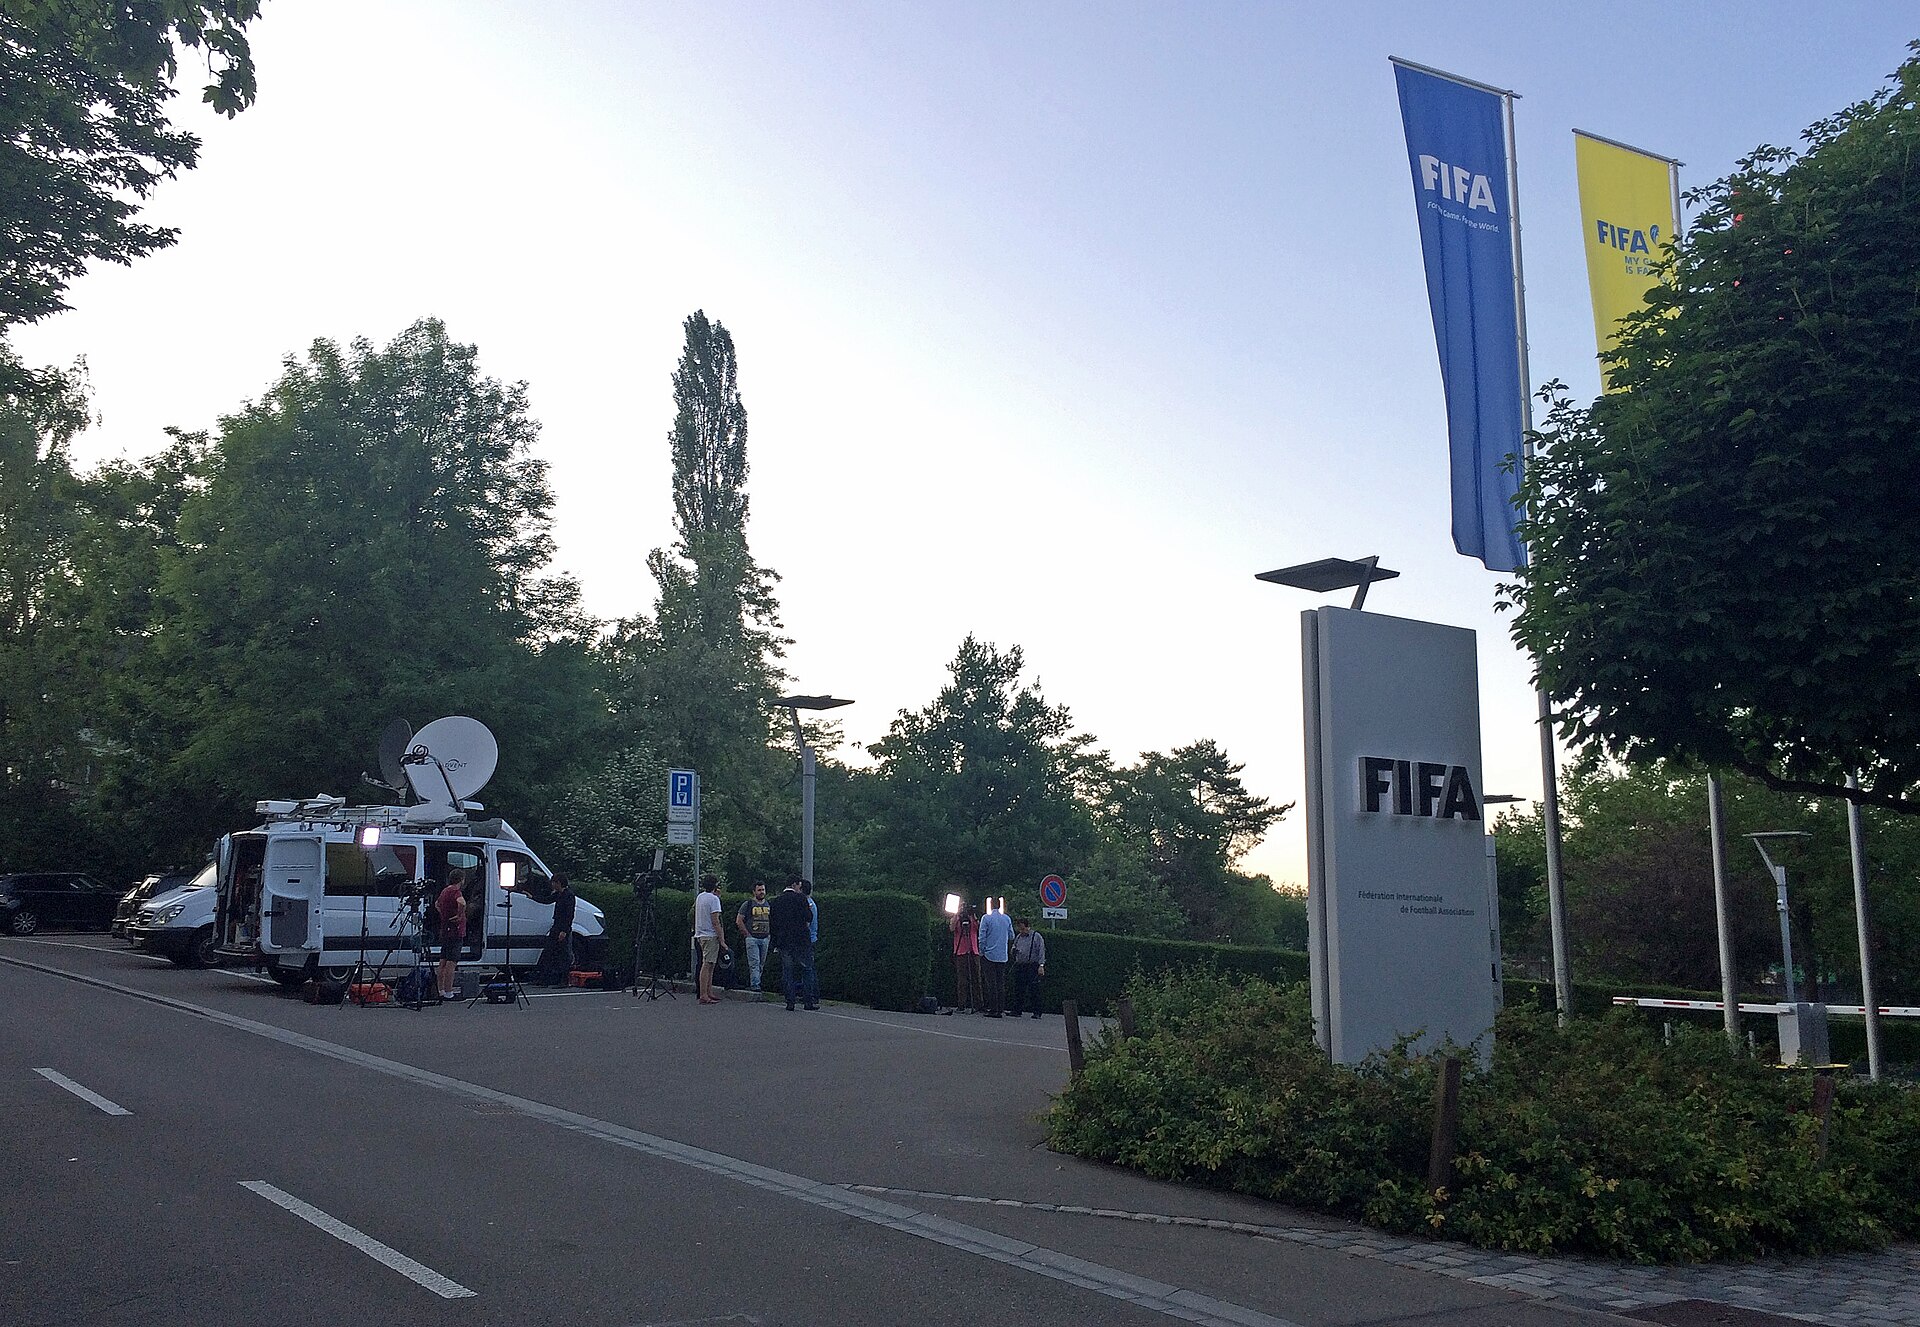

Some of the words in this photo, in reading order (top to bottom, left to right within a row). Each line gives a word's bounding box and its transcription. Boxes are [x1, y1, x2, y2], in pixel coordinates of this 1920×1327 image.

[1419, 154, 1497, 214] FIFA
[1597, 219, 1649, 255] FIFA
[1624, 256, 1639, 265] MY
[1626, 265, 1633, 274] IS
[678, 776, 687, 791] P
[1358, 757, 1481, 821] FIFA
[1358, 890, 1395, 900] Fédération
[1396, 892, 1443, 903] Internationale
[1400, 905, 1409, 914] de
[1410, 905, 1437, 915] Football
[1438, 907, 1475, 916] Association
